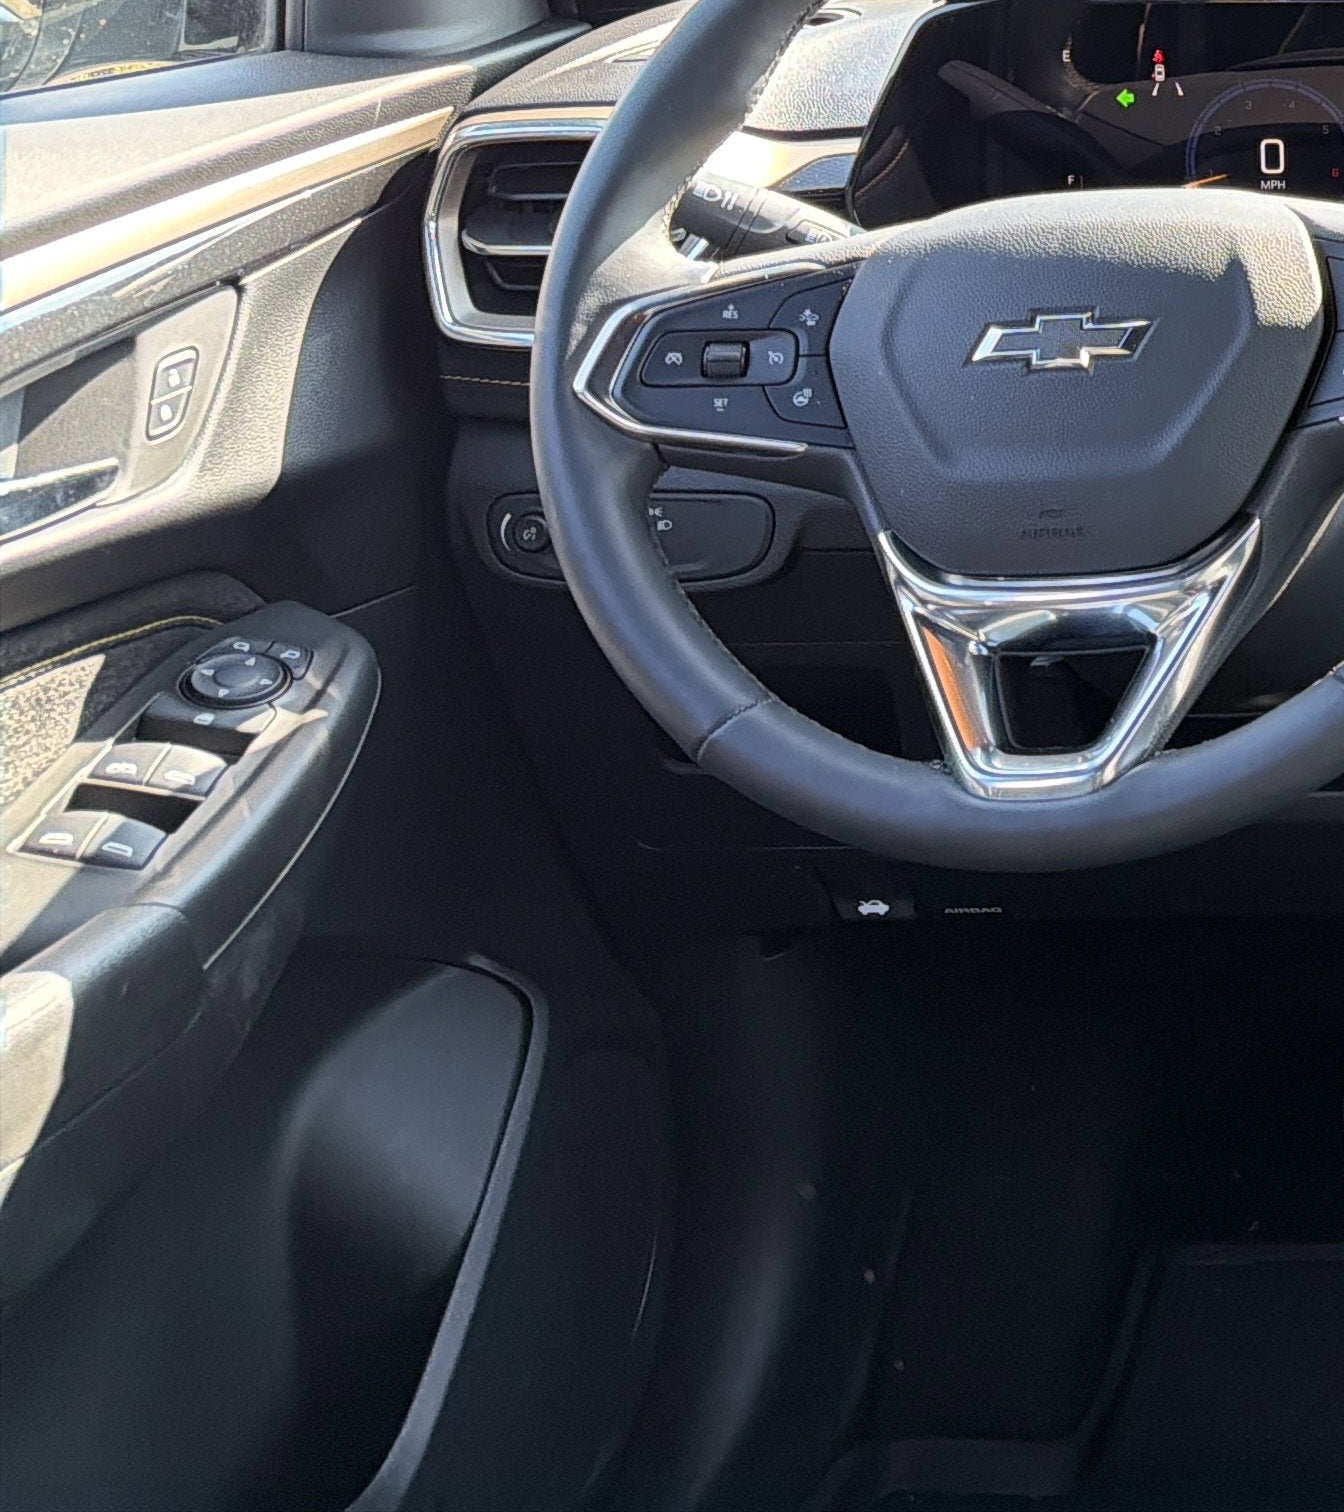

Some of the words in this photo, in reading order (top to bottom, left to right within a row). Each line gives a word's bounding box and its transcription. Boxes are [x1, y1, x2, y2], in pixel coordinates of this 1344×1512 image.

[1062, 49, 1072, 63] E
[1260, 138, 1285, 175] 0
[1067, 175, 1075, 185] F
[1260, 180, 1286, 190] MPH
[722, 309, 739, 320] RES
[713, 399, 728, 408] SET
